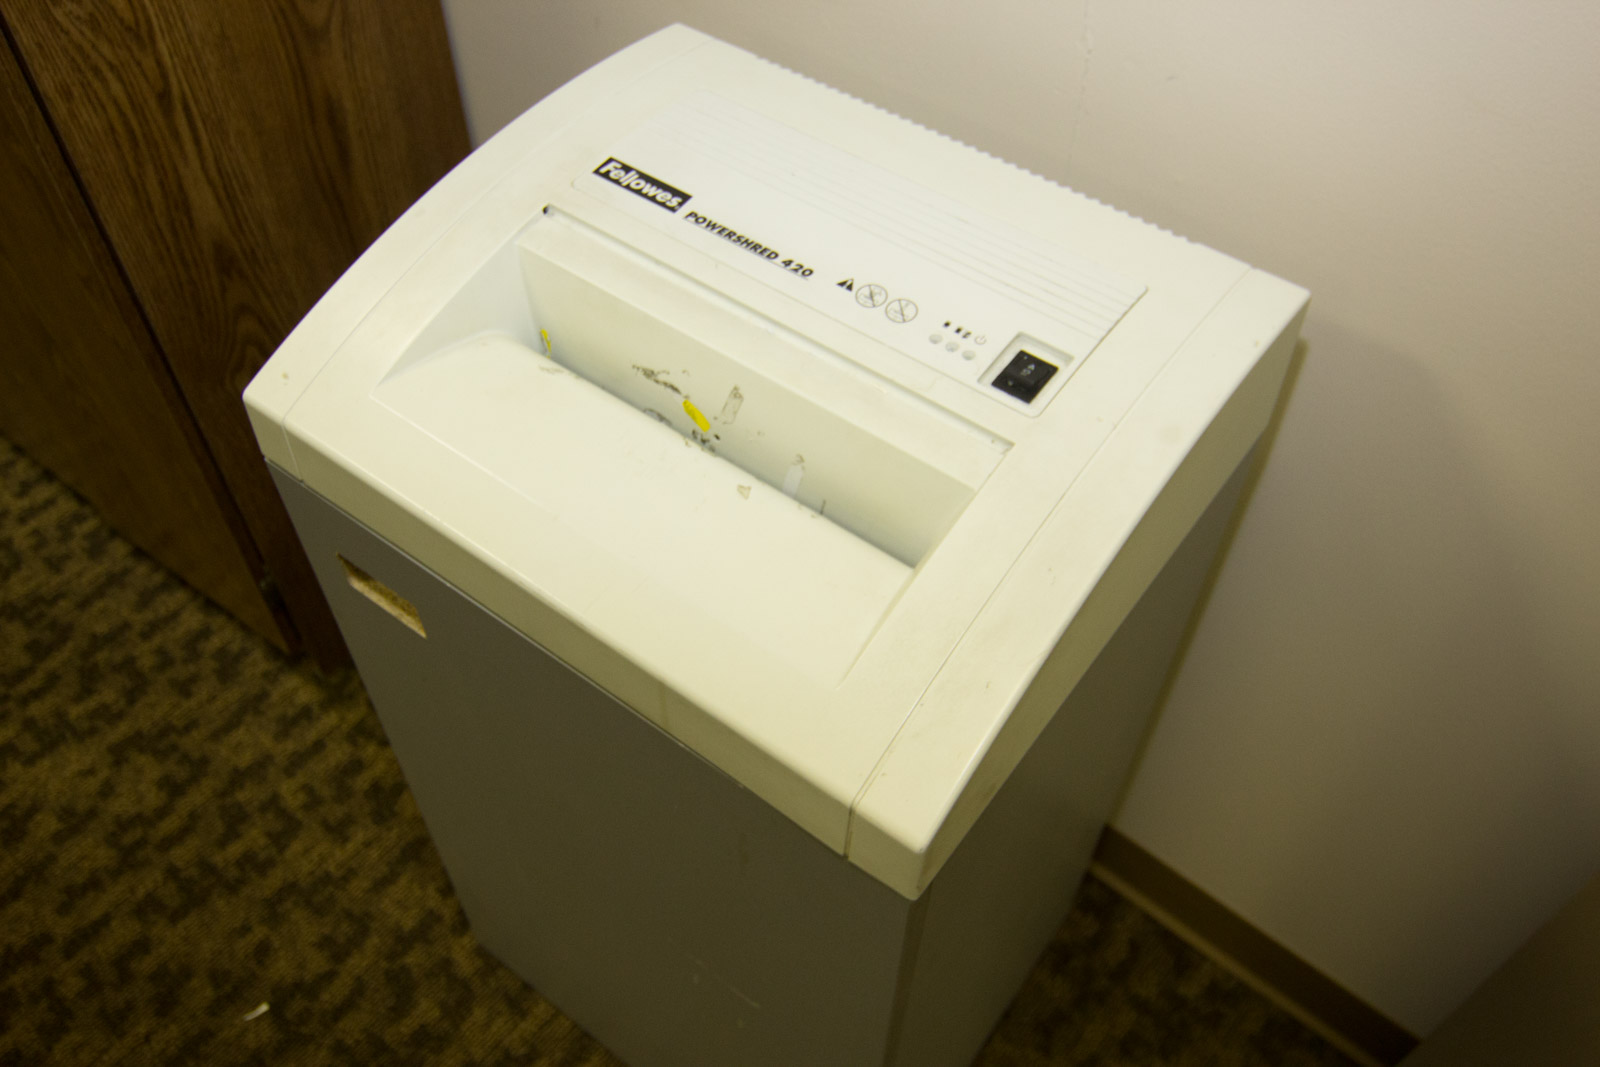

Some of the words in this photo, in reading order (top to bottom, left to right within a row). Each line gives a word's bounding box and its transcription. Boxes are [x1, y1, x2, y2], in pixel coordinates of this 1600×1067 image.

[599, 160, 682, 209] Fellowes
[685, 211, 779, 262] POWERSHRED
[781, 259, 814, 278] 420
